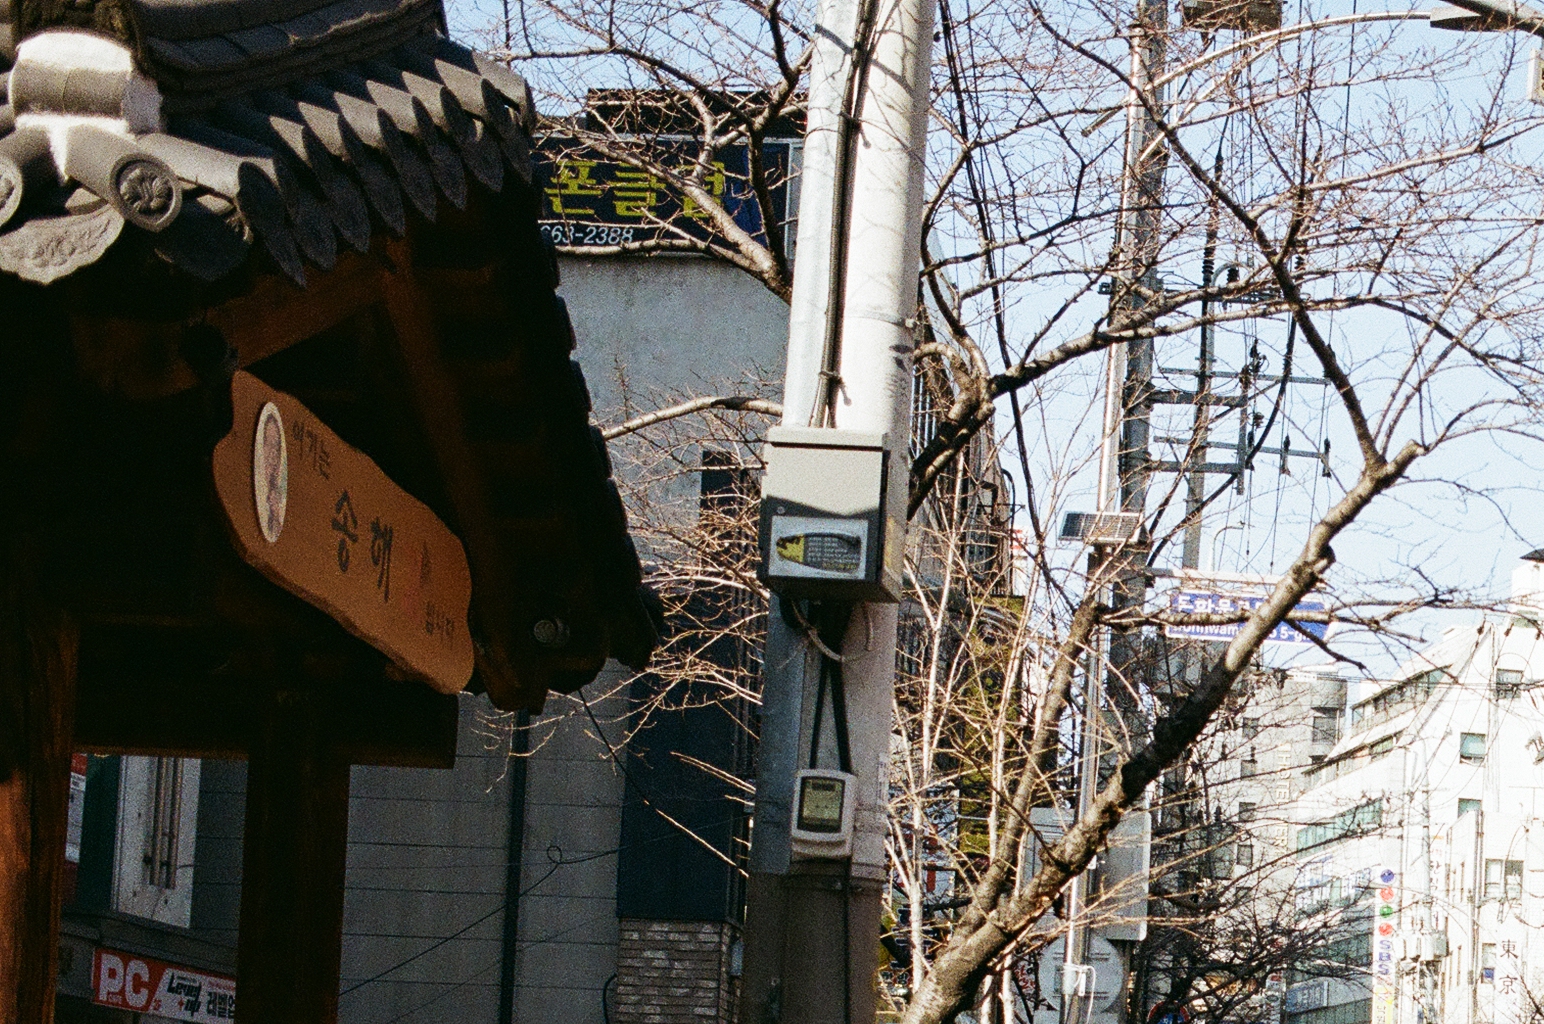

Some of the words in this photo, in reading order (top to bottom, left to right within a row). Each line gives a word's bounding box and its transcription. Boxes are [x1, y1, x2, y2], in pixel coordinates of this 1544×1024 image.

[292, 419, 331, 481] 여기는
[331, 489, 393, 604] 송해
[100, 953, 150, 1008] PC
[1500, 939, 1519, 995] 東京
